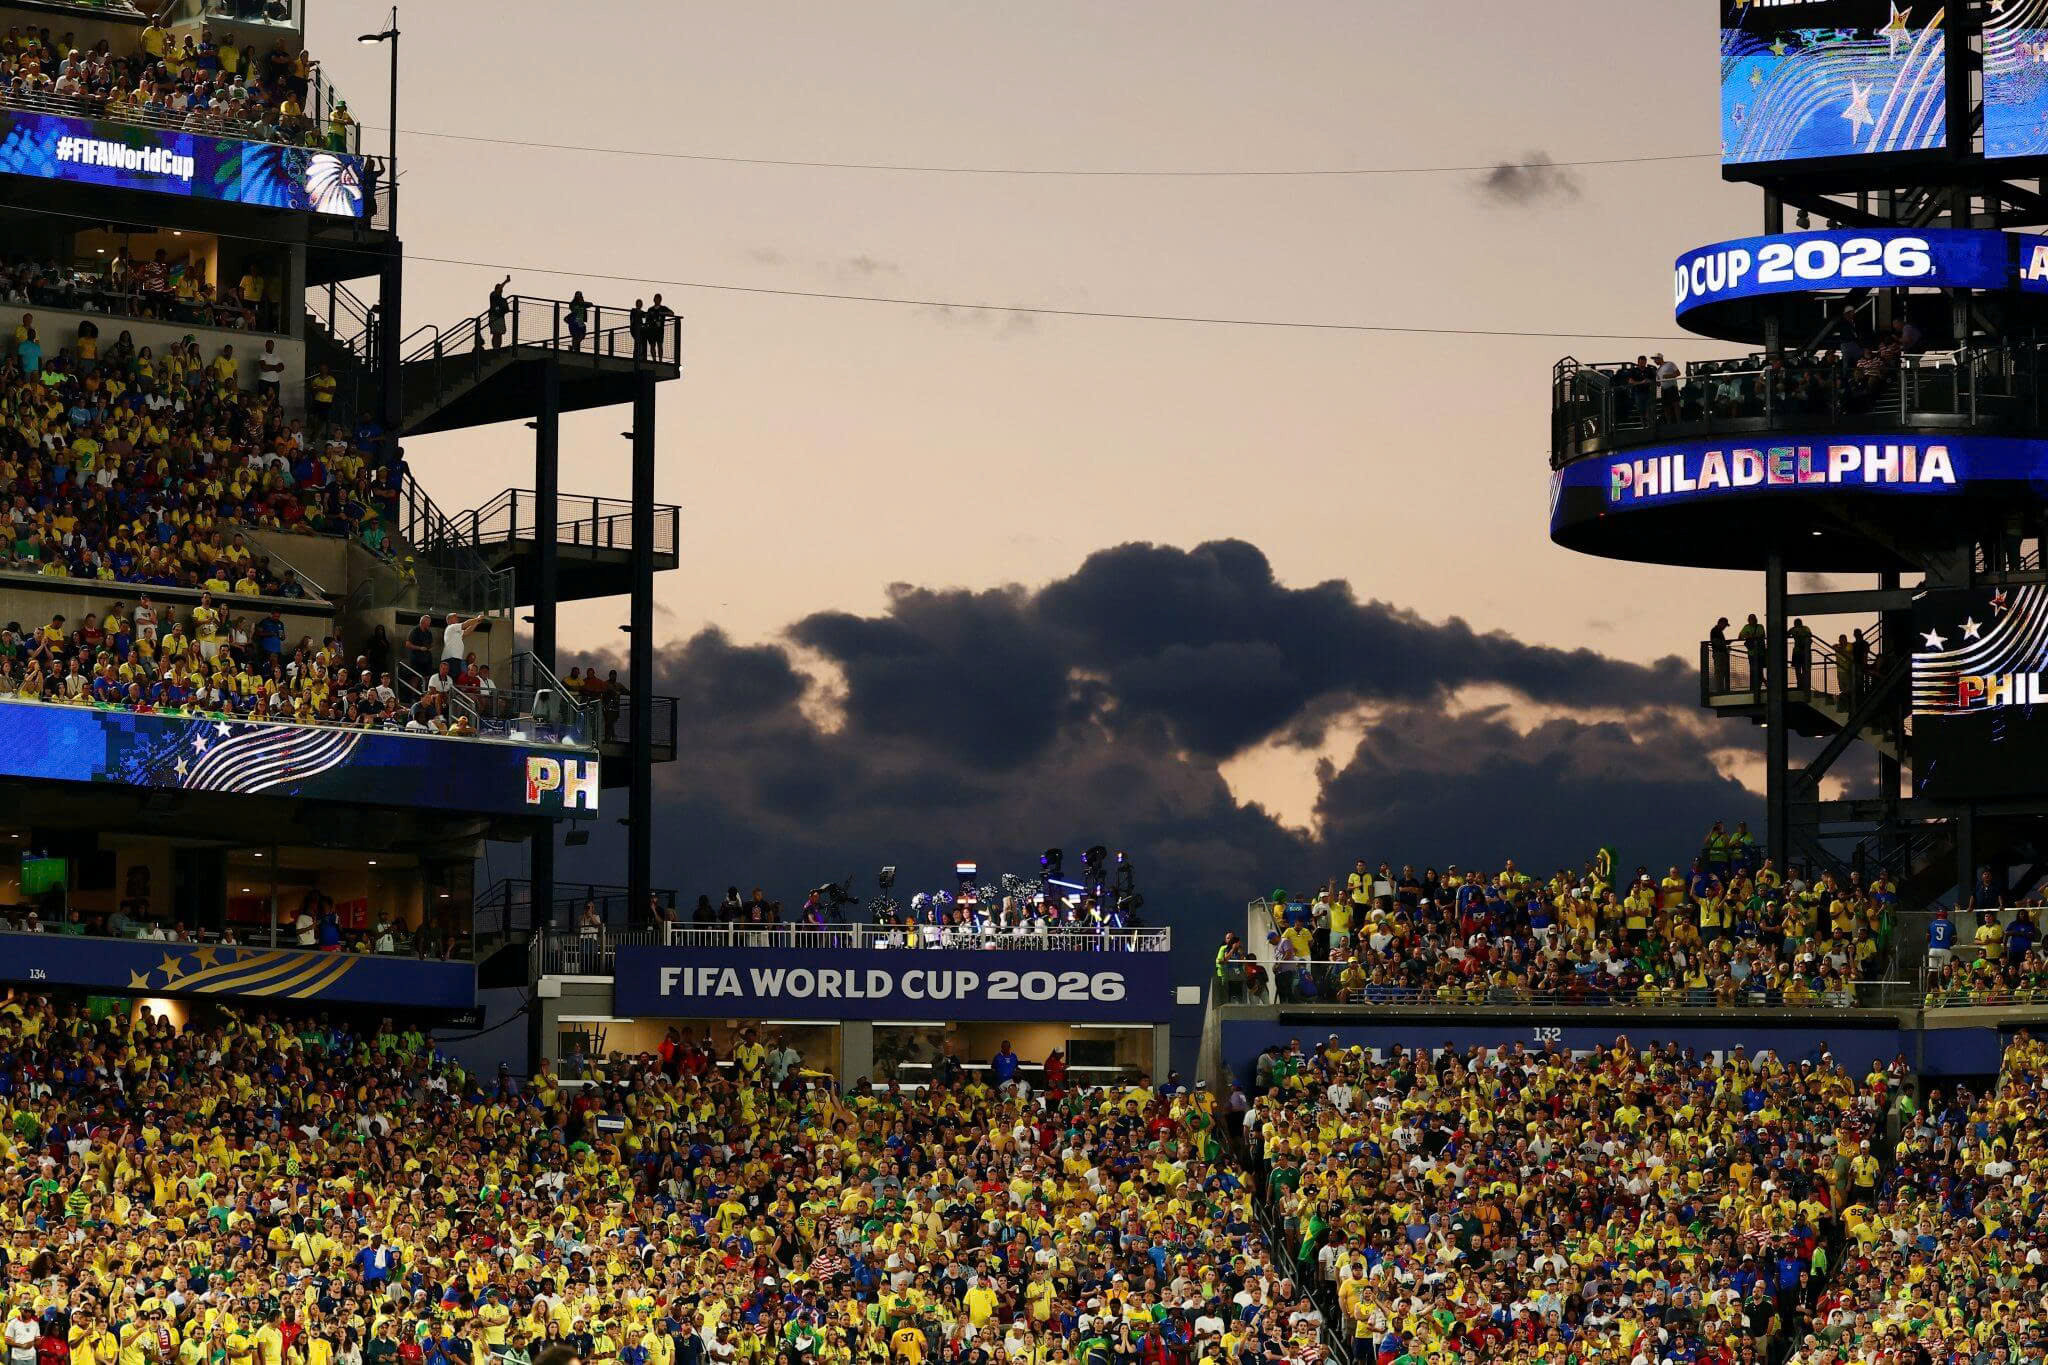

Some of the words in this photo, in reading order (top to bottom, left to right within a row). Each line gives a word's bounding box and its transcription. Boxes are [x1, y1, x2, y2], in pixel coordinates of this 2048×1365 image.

[56, 136, 194, 181] #FIFAWorldCup
[1691, 249, 1751, 296] CUP
[1611, 445, 1956, 501] PHILADELPHIA
[1959, 672, 2048, 707] PHIL
[526, 756, 599, 810] PH
[29, 968, 46, 979] 134
[660, 967, 743, 996] FIFA
[750, 968, 893, 998] WORLD
[901, 970, 980, 999] CUP
[987, 970, 1126, 1001] 2026
[1533, 1027, 1561, 1042] 132
[900, 1332, 915, 1343] 37
